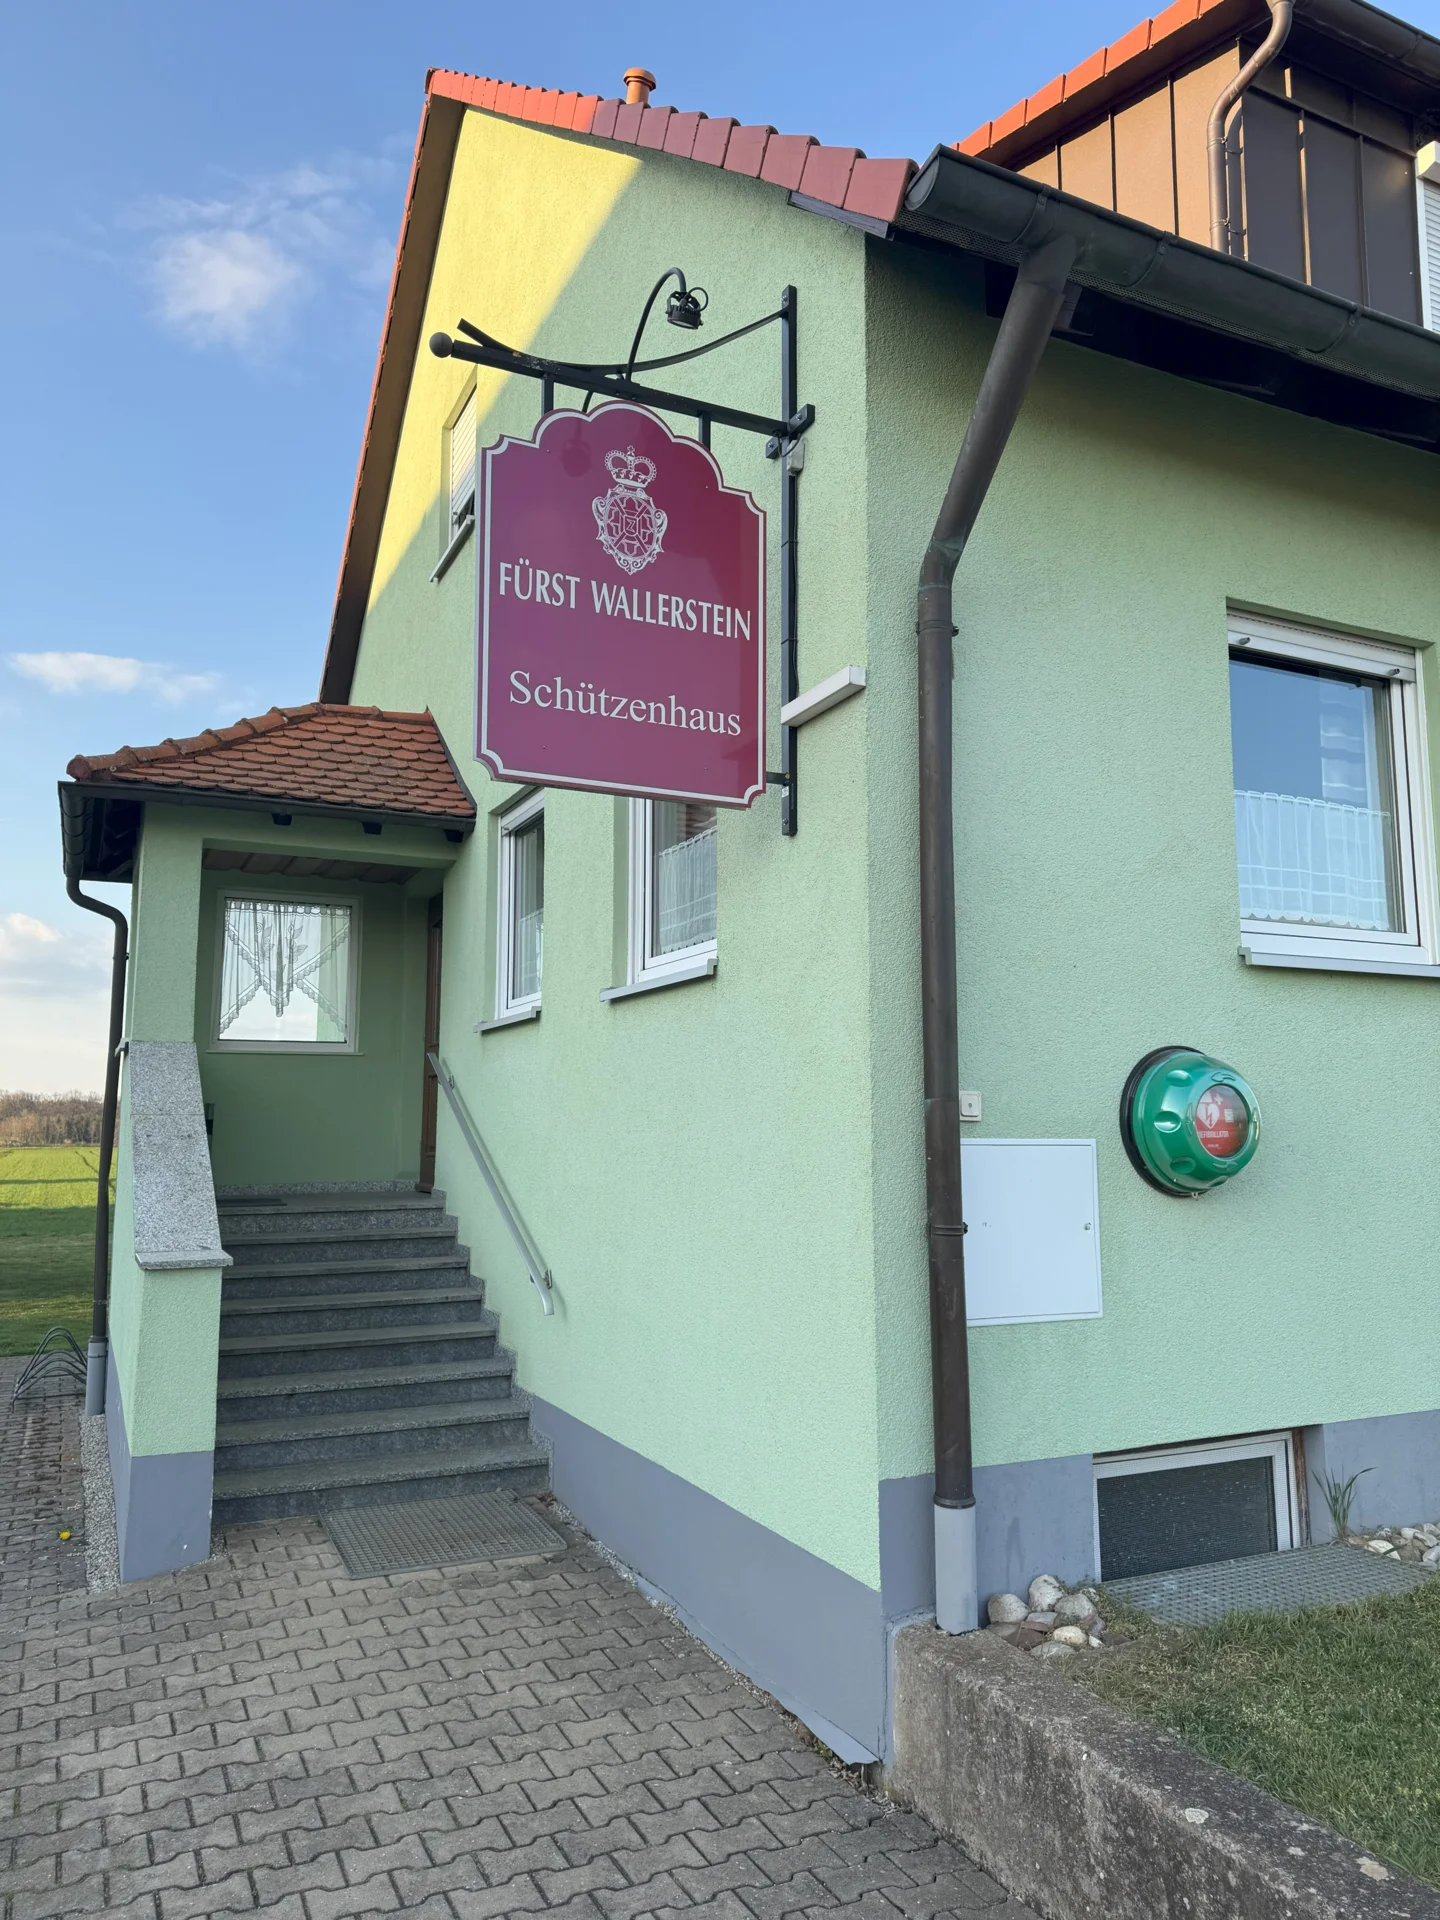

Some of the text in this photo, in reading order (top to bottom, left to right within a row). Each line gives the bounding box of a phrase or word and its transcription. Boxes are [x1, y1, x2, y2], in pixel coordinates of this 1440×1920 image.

[499, 557, 751, 641] FÜRST WALLERSTEIN
[509, 670, 742, 736] Schützenhaus
